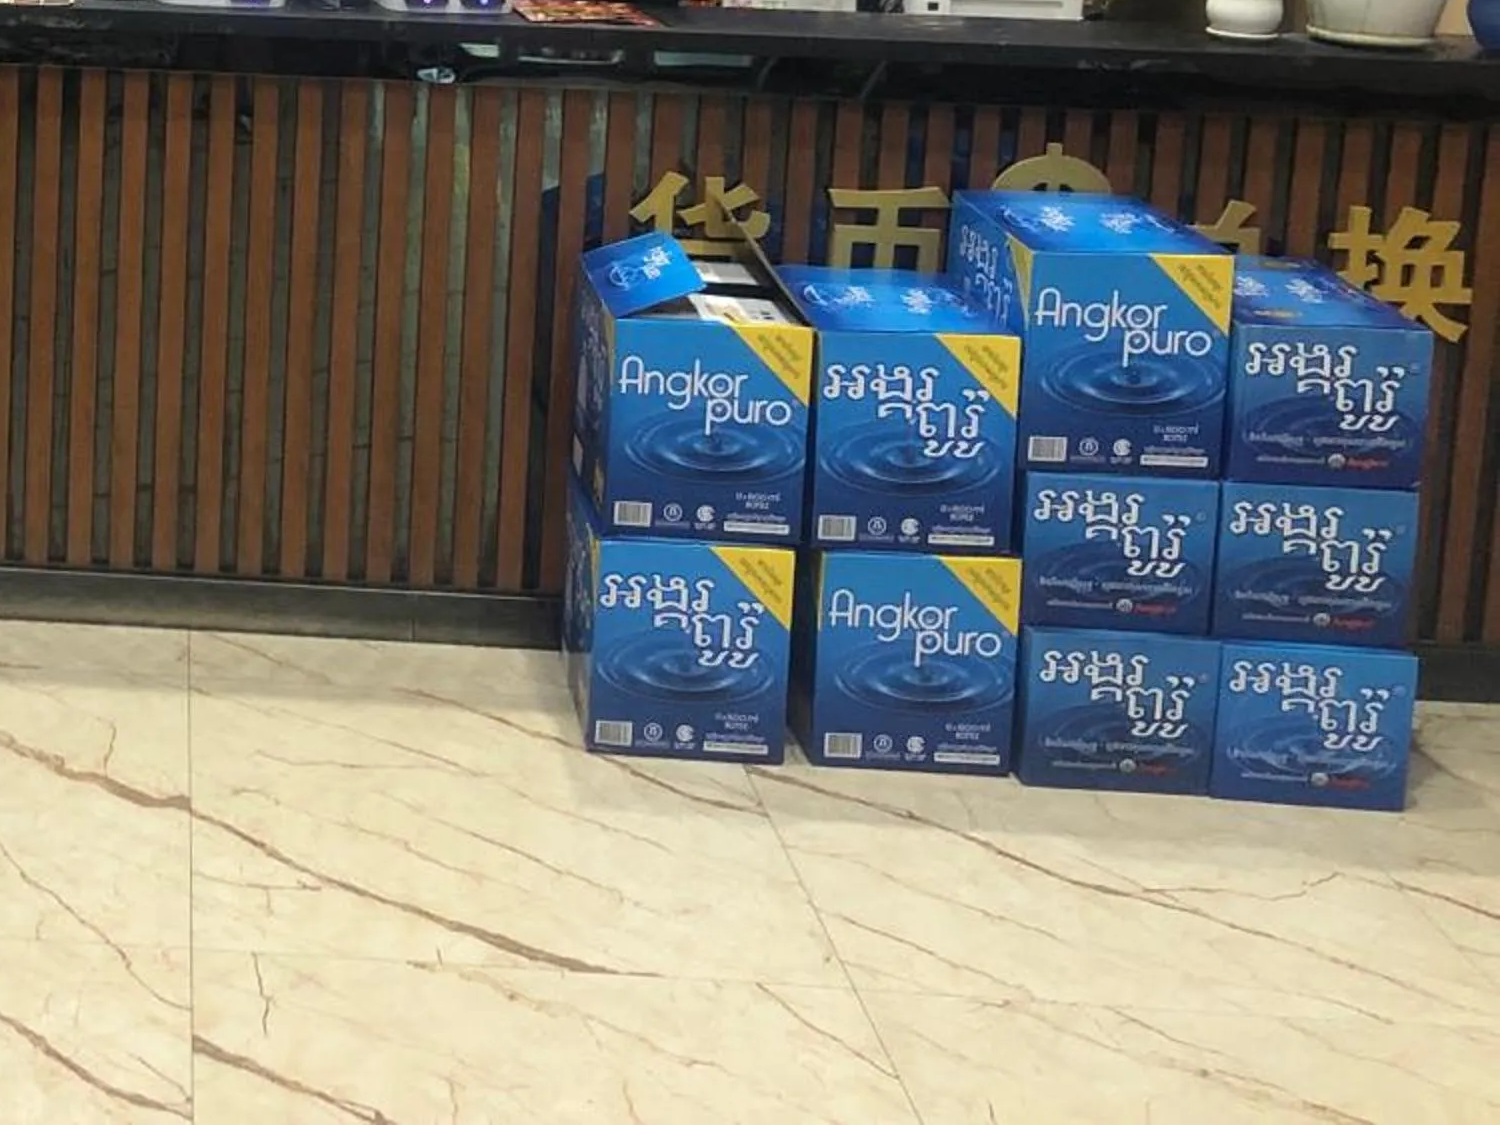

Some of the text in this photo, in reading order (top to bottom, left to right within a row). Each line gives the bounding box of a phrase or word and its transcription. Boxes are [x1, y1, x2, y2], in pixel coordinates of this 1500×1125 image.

[1035, 287, 1167, 342] Angkor
[1123, 323, 1212, 367] puro
[619, 355, 748, 409] Angkor
[706, 394, 791, 435] puro
[829, 589, 958, 641] Angkor
[914, 630, 1001, 667] puro
